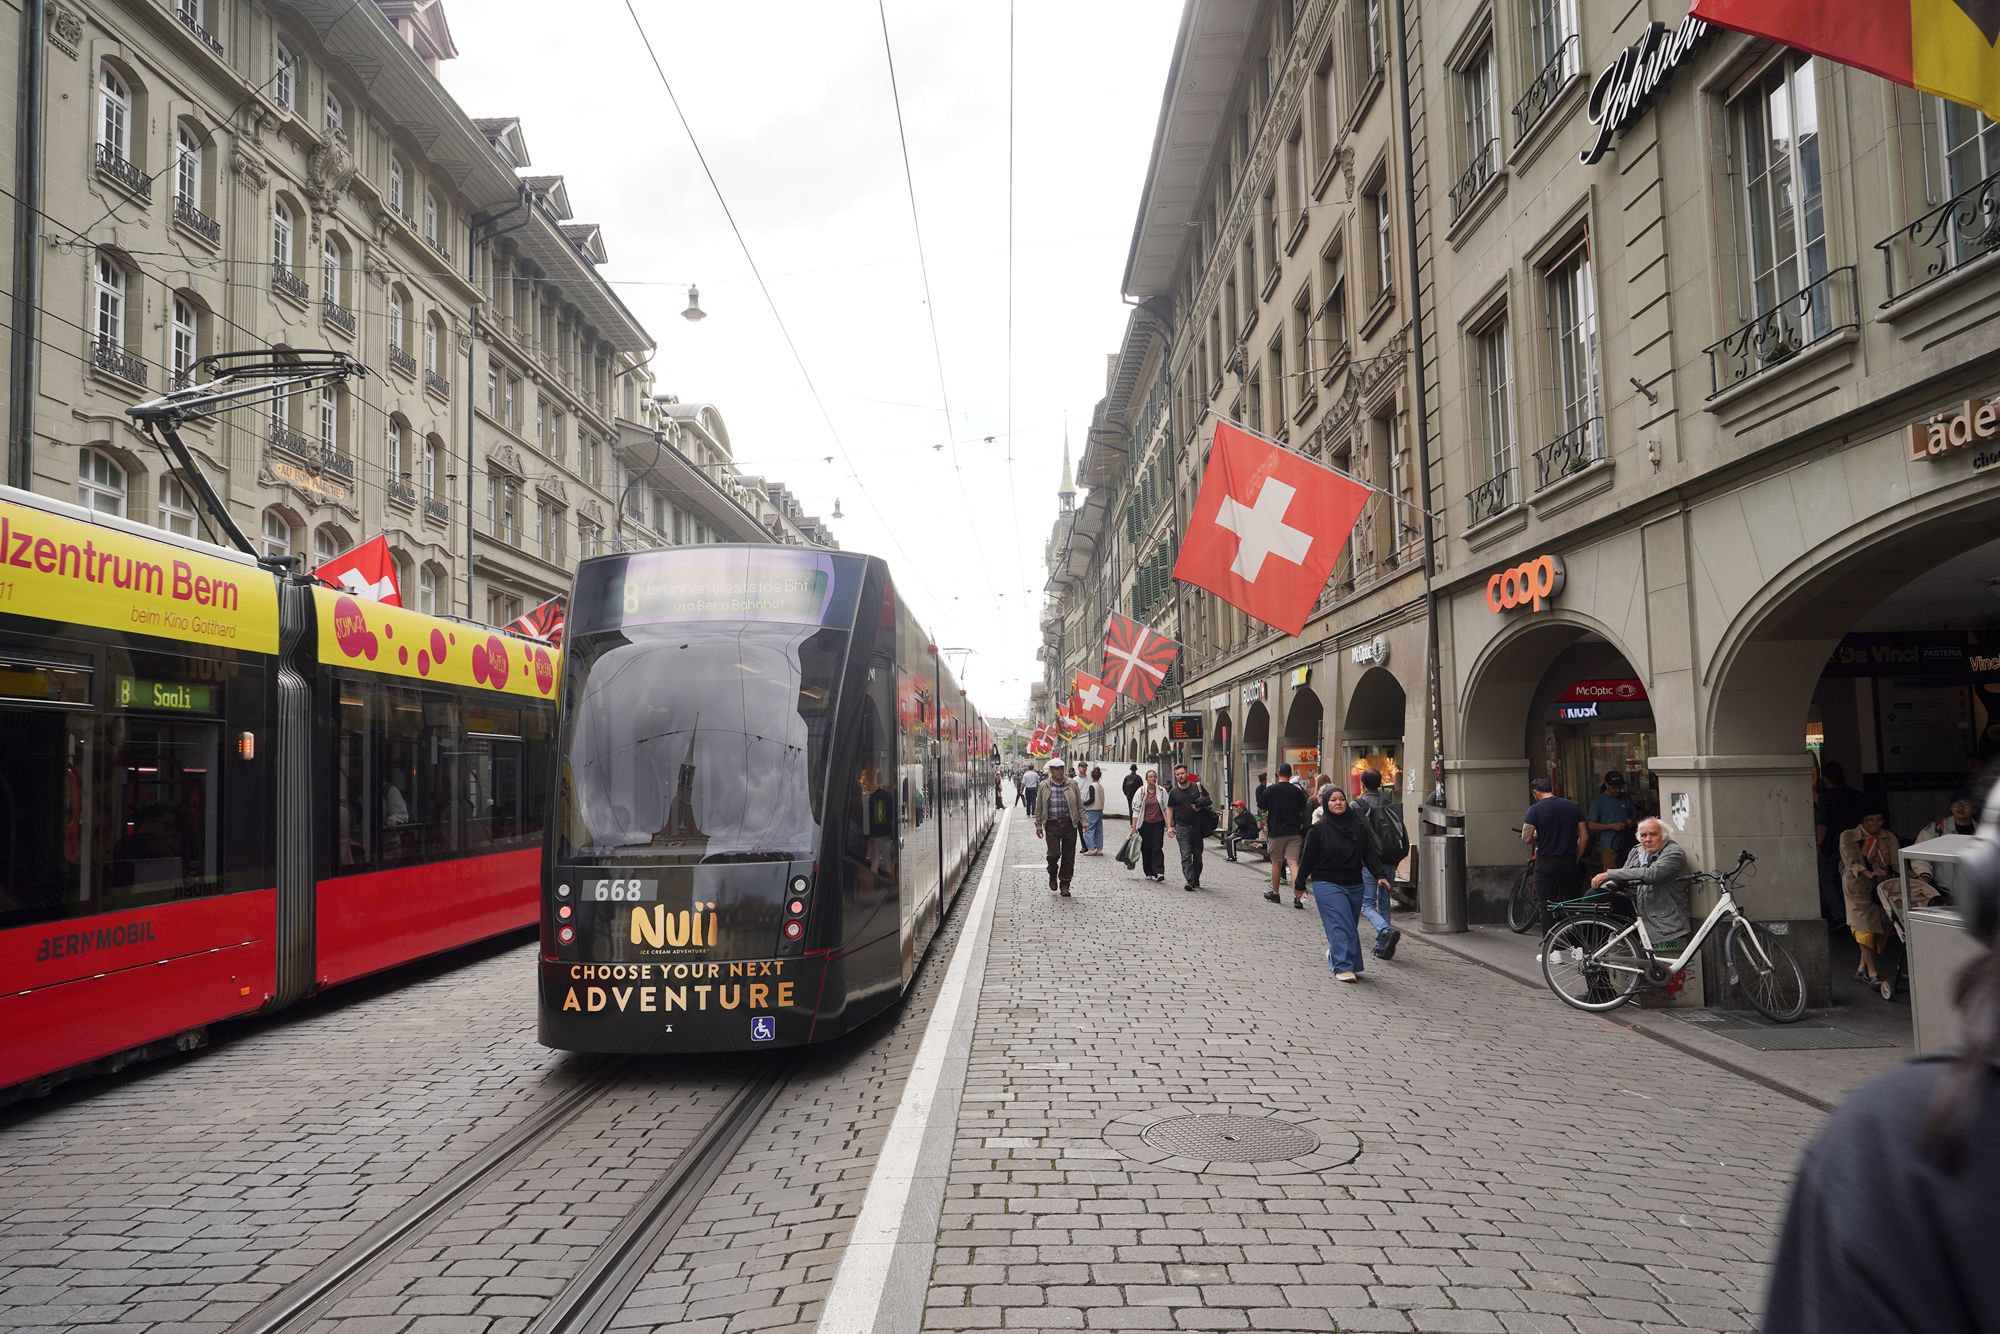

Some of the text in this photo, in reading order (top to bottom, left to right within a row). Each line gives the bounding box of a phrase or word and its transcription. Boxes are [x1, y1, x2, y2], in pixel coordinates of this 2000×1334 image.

[172, 559, 238, 611] Bern
[785, 577, 810, 593] Bhf
[1487, 555, 1554, 614] coop
[697, 599, 729, 612] Bern
[732, 597, 786, 611] Bahnhof
[131, 605, 236, 639] beim Kino Gotthard
[1840, 645, 1963, 664] Da Vinci PASTERIA
[153, 683, 192, 710] Saali
[1576, 686, 1613, 697] McOptic
[595, 879, 641, 901] 668
[630, 901, 718, 949] Nuii
[37, 920, 156, 962] BERNMOBIL
[571, 961, 784, 980] CHOOSE YOUR NEXT
[562, 981, 795, 1012] ADVENTURE
